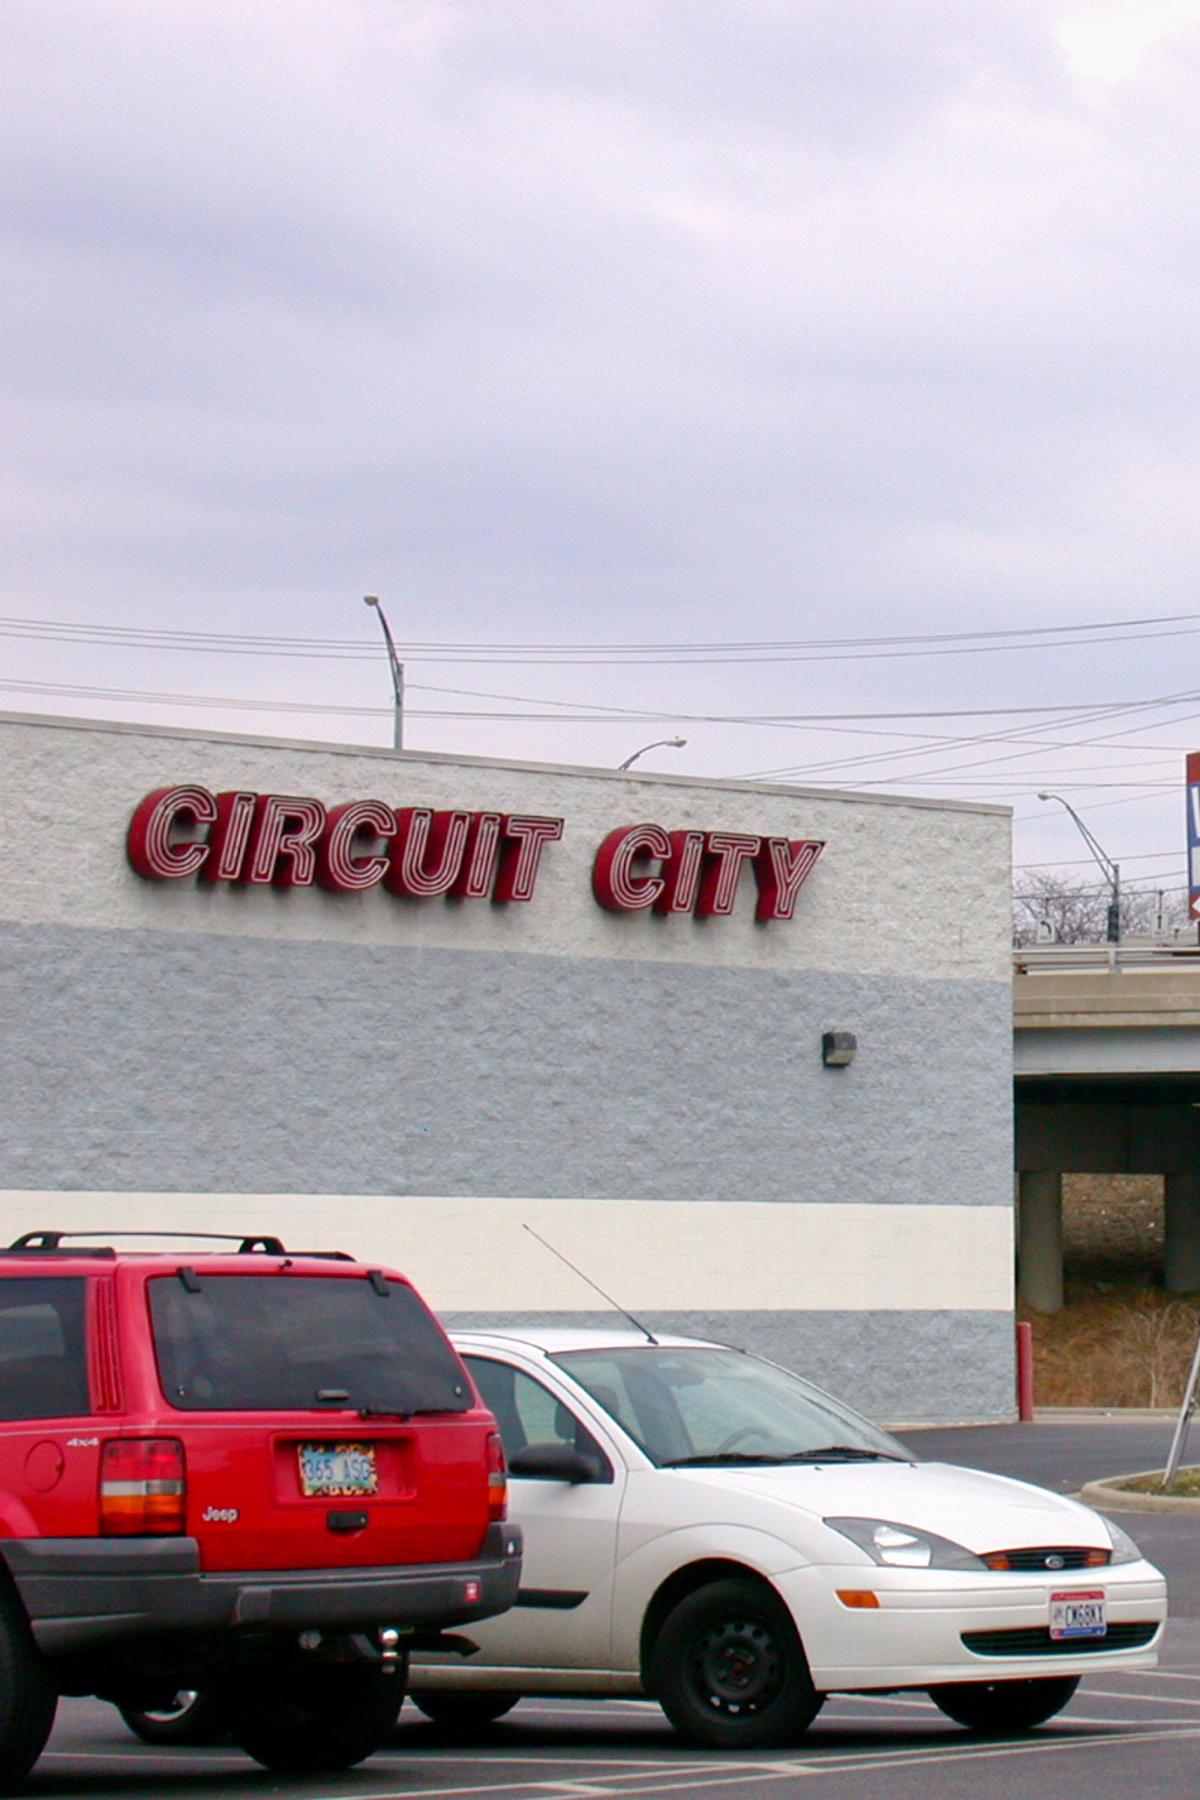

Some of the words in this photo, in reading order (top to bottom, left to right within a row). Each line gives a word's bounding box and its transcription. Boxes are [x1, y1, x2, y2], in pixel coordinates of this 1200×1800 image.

[127, 784, 565, 902] CIRCUIT
[594, 822, 826, 921] CITY
[65, 1437, 100, 1448] 4x4
[202, 1506, 239, 1523] Jeep
